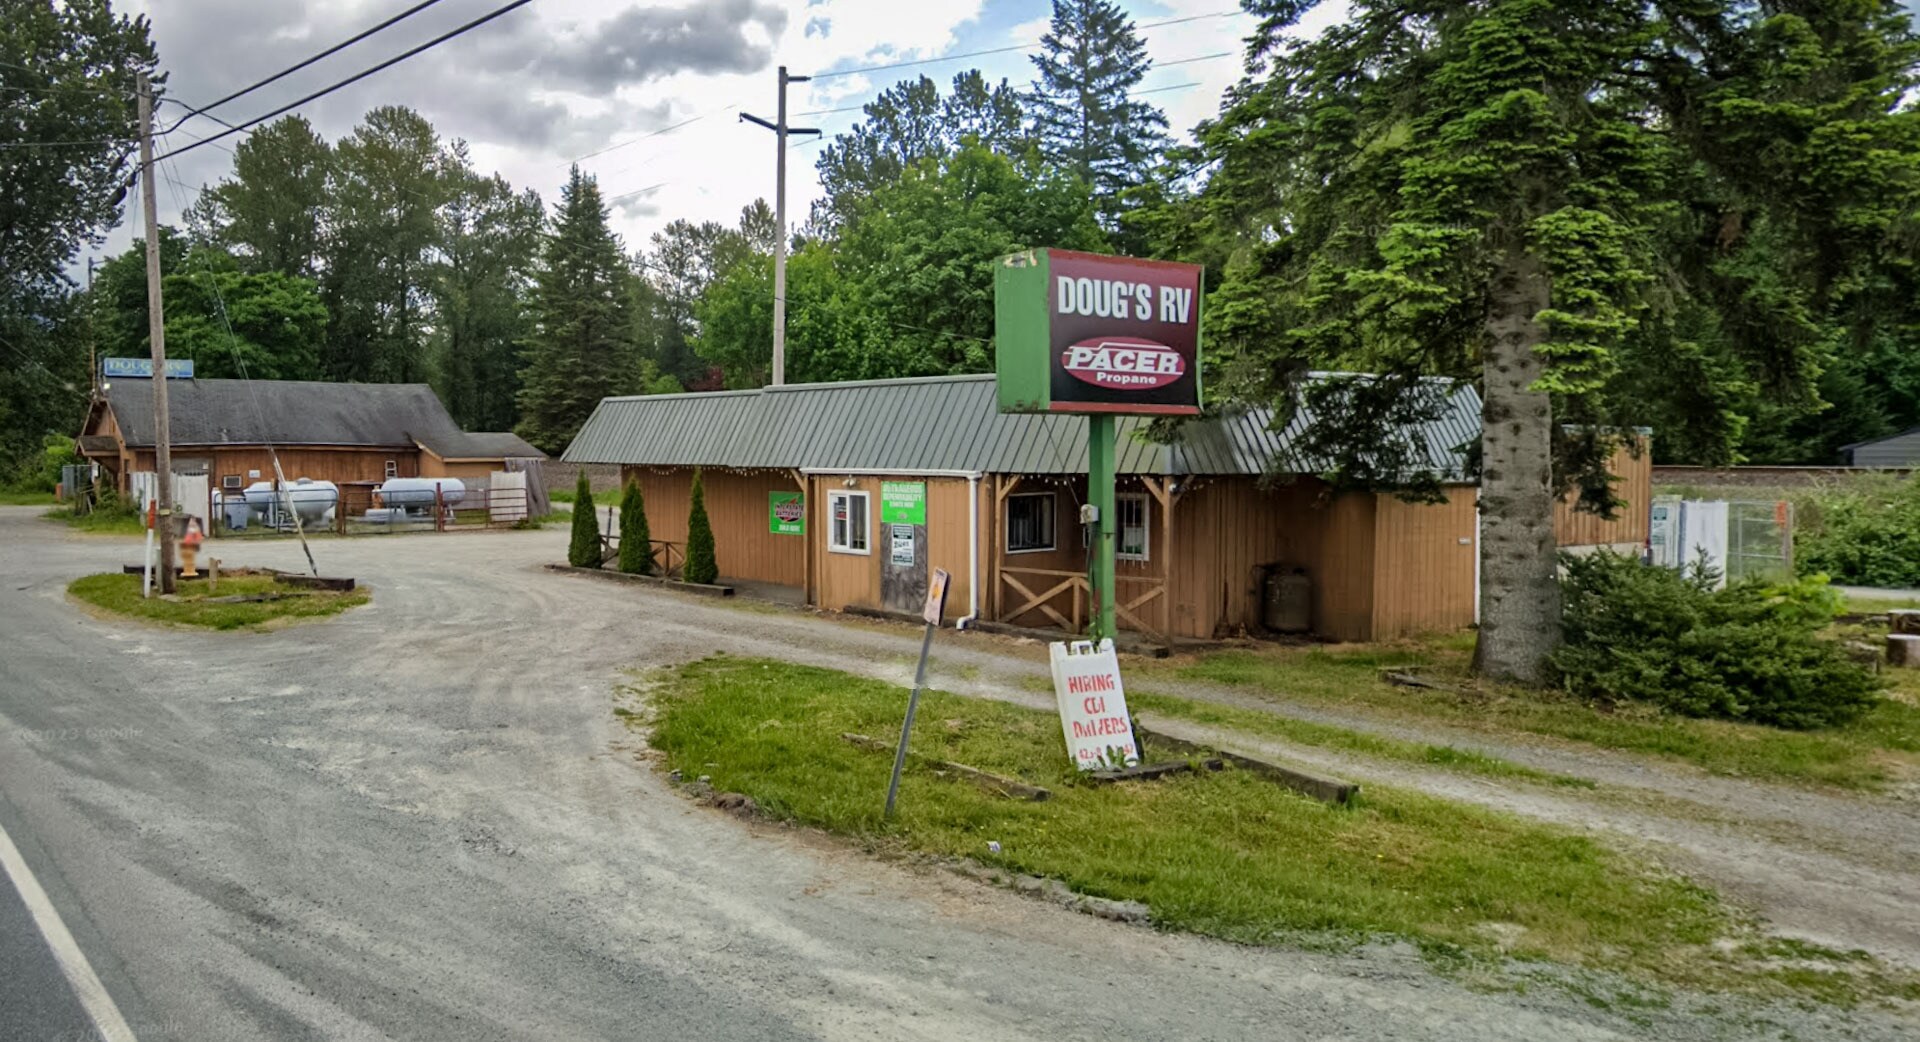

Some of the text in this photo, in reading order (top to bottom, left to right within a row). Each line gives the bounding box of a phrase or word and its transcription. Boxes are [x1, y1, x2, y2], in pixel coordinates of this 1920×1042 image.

[1057, 276, 1192, 323] DOUG'S RV
[1067, 348, 1180, 373] PACER
[1096, 371, 1157, 385] Propane
[1068, 674, 1115, 693] HIRING
